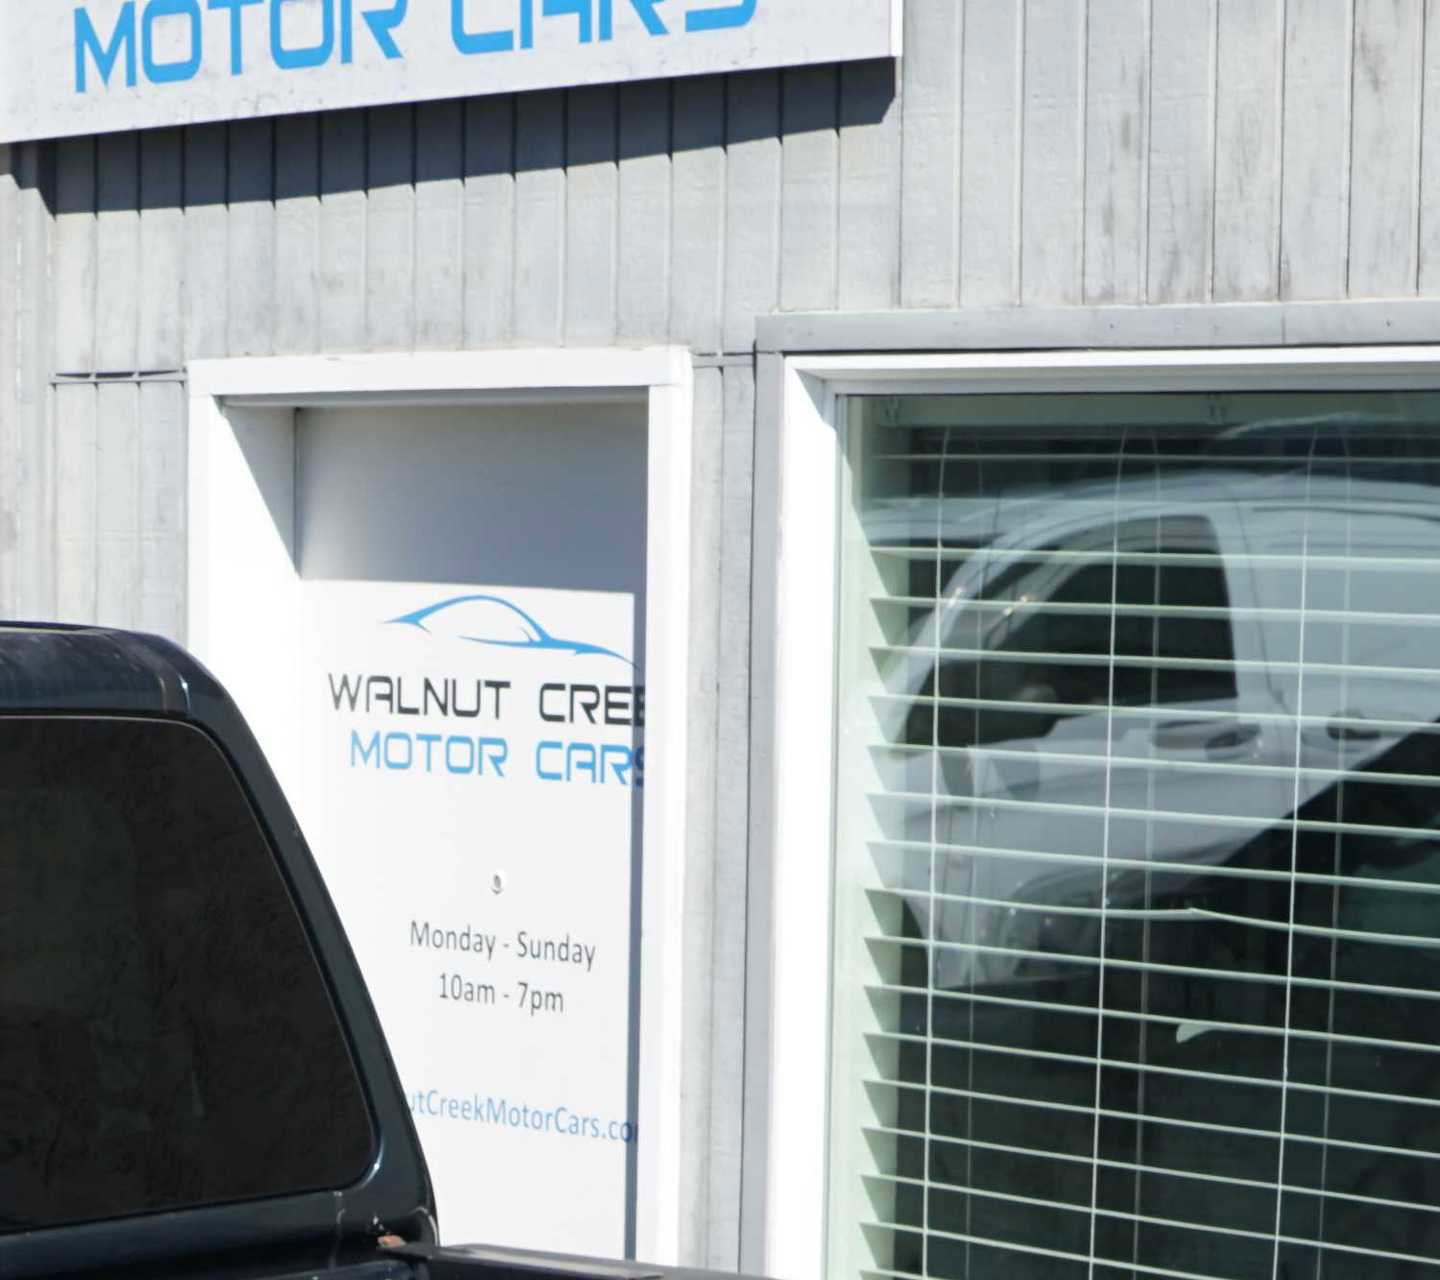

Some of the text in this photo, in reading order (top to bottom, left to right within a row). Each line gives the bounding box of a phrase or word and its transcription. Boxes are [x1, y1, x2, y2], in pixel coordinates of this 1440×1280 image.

[75, 0, 408, 93] MOTOR
[327, 672, 511, 721] WALNUT
[350, 729, 509, 778] MOTOR
[410, 920, 497, 959] Monday
[516, 930, 597, 971] Sunday
[439, 973, 496, 1006] 10am
[517, 982, 565, 1016] 7pm
